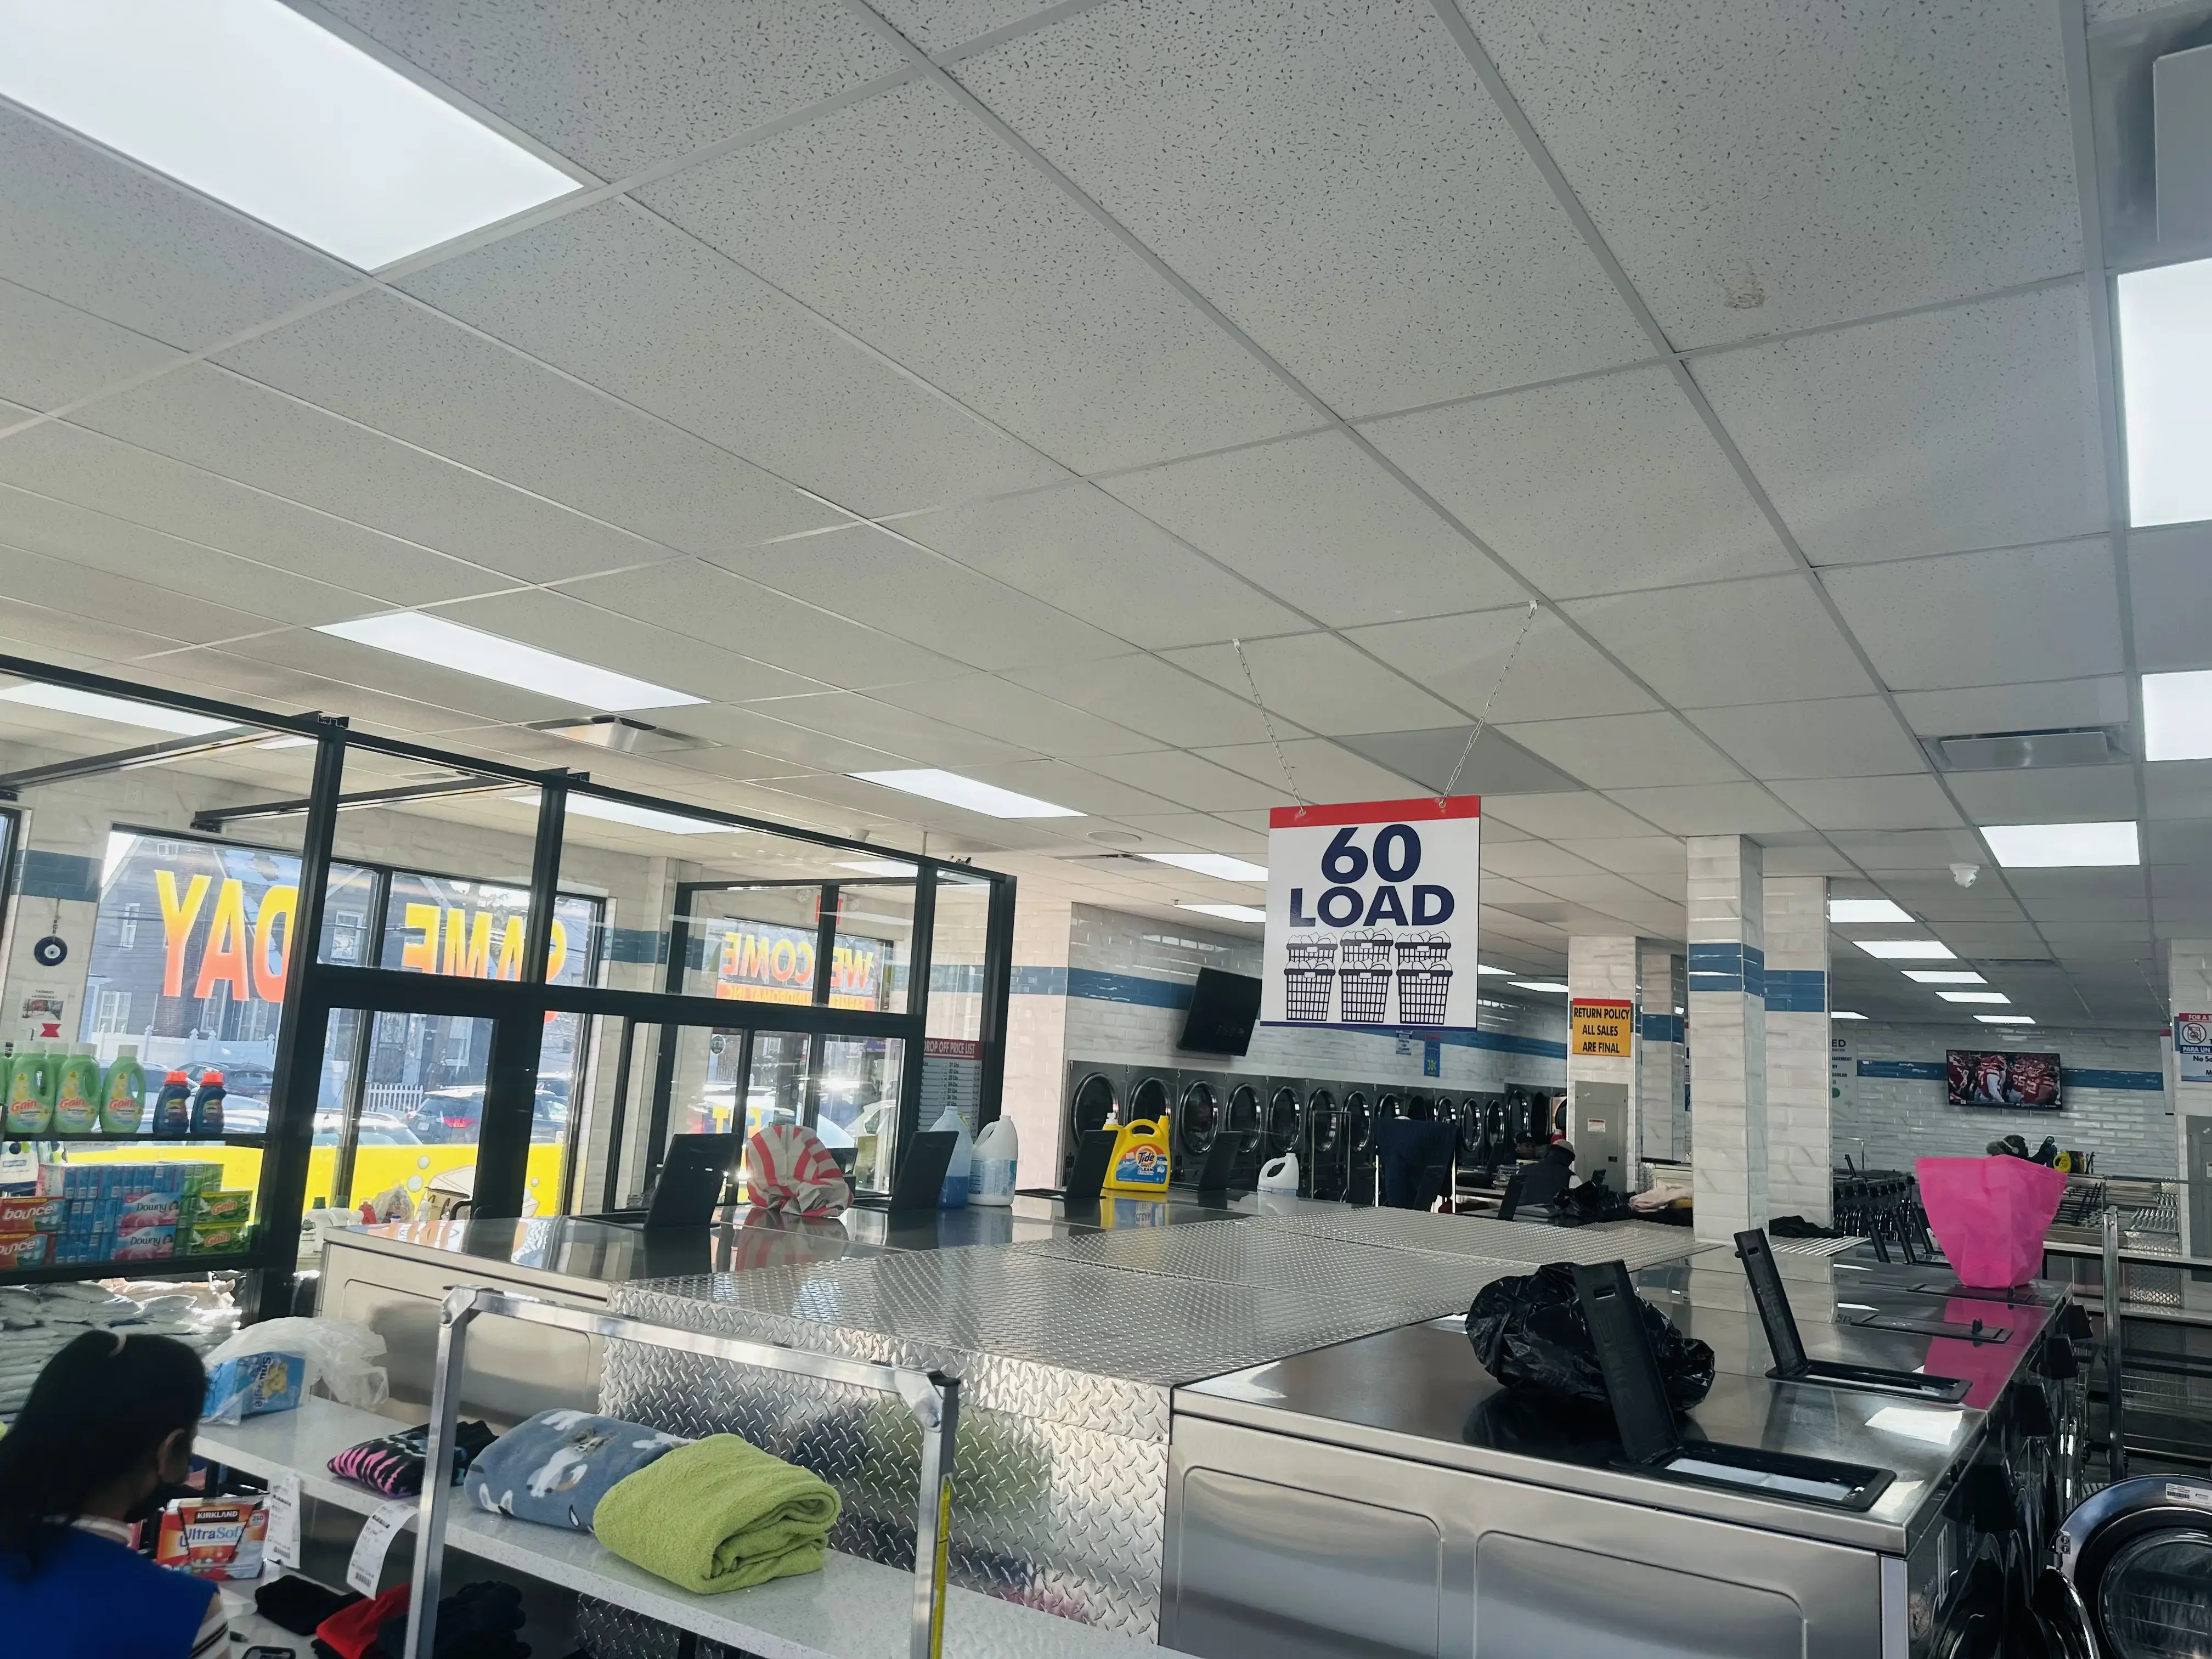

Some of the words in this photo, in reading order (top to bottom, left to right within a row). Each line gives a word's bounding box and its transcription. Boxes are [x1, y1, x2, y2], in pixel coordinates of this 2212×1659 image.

[1321, 824, 1421, 884] 60
[1290, 884, 1454, 928] LOAD
[1574, 1007, 1602, 1018] RETURN
[1604, 1008, 1630, 1020] POLICY
[1582, 1024, 1595, 1035] ALL
[1597, 1025, 1618, 1036] SALES
[939, 1041, 950, 1053] OFF
[950, 1042, 964, 1054] PRICE
[965, 1043, 975, 1055] LIST
[1583, 1041, 1596, 1052] ARE
[1599, 1042, 1620, 1053] FINAL
[11, 1099, 38, 1113] Gain
[59, 1098, 84, 1110] Gain
[109, 1098, 134, 1109] Gain
[1138, 1152, 1155, 1164] Tide
[3, 1204, 54, 1220] bounce
[137, 1203, 167, 1212] Downy
[212, 1201, 237, 1214] Gain
[131, 1237, 162, 1246] Downy
[205, 1233, 230, 1246] Gain
[196, 1511, 238, 1519] KIRKLAND
